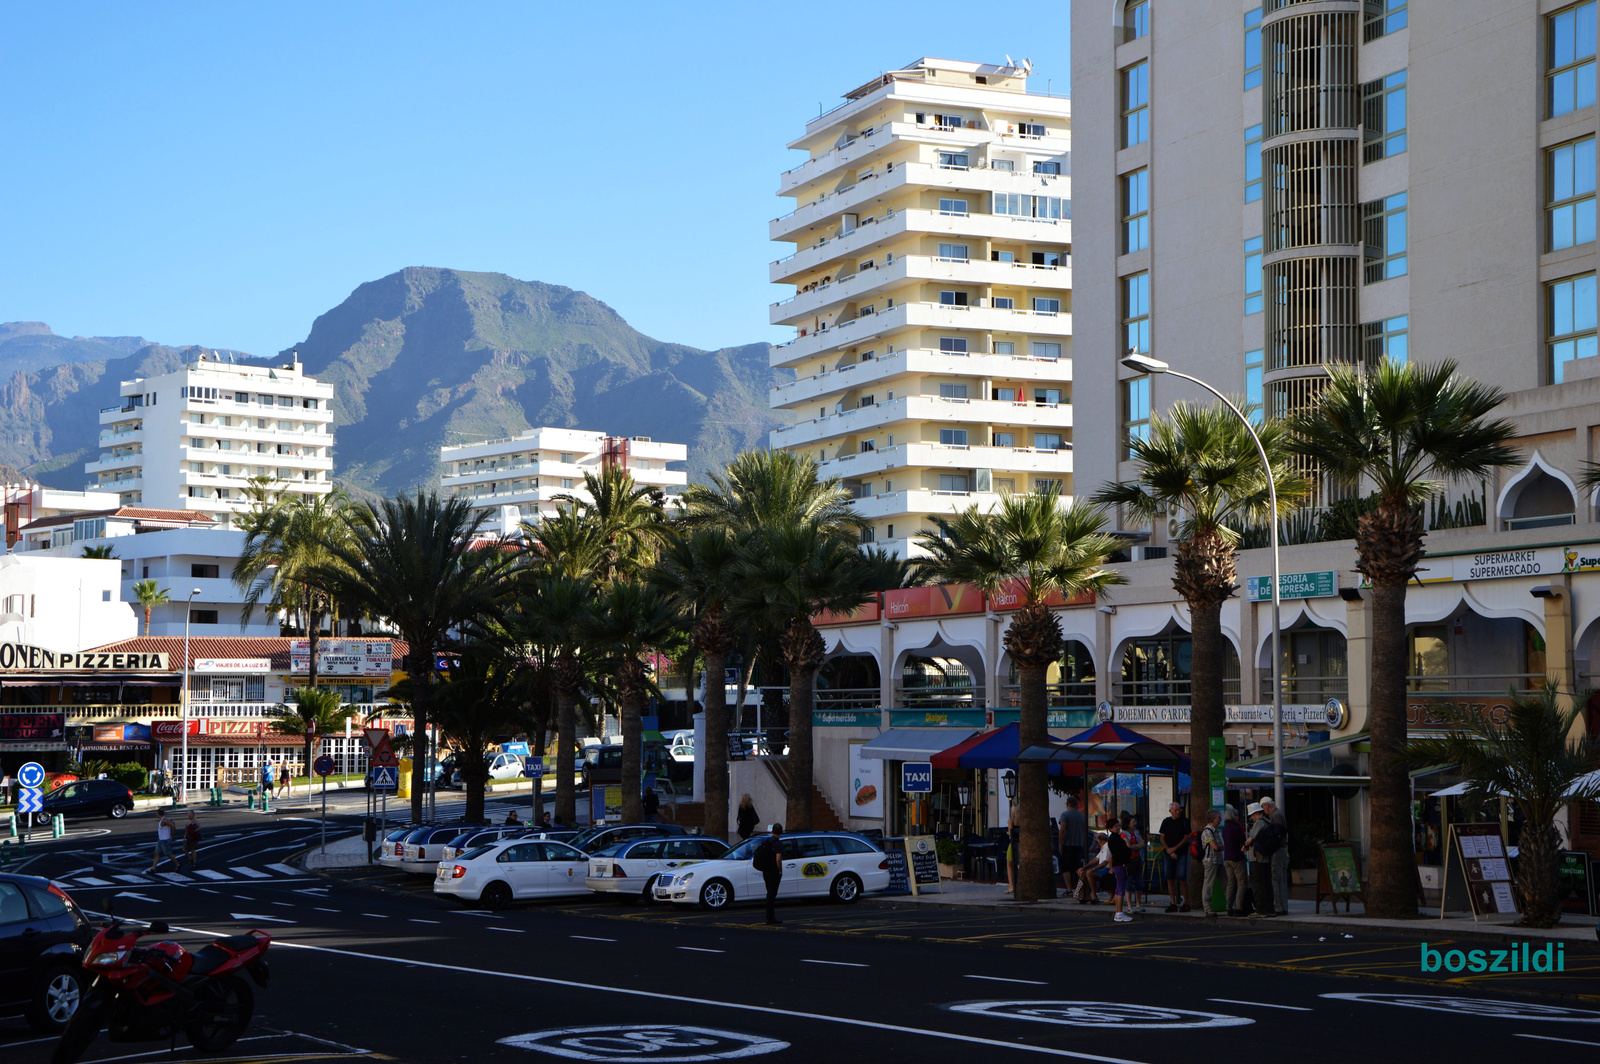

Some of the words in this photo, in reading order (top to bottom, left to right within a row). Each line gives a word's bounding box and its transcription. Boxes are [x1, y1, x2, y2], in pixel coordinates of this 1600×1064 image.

[1474, 551, 1536, 565] SUPERMARKET
[1470, 563, 1541, 578] SUPERMERCADO
[1267, 574, 1308, 585] AESORIA
[1261, 586, 1271, 595] DE
[1279, 583, 1315, 594] MPRESAS
[0, 643, 55, 669] ONEN
[60, 653, 162, 669] PIZZERIA
[1047, 712, 1067, 722] arket
[1118, 708, 1158, 721] BOHEMIAN
[1228, 708, 1262, 720] Restaurante
[1303, 707, 1325, 720] Pizzeri
[0, 714, 63, 728] DEEN
[4, 729, 47, 738] HOUSE
[527, 763, 542, 771] TAXI
[905, 772, 930, 782] TAXI
[1016, 1006, 1182, 1022] 30
[561, 1031, 719, 1054] 30
